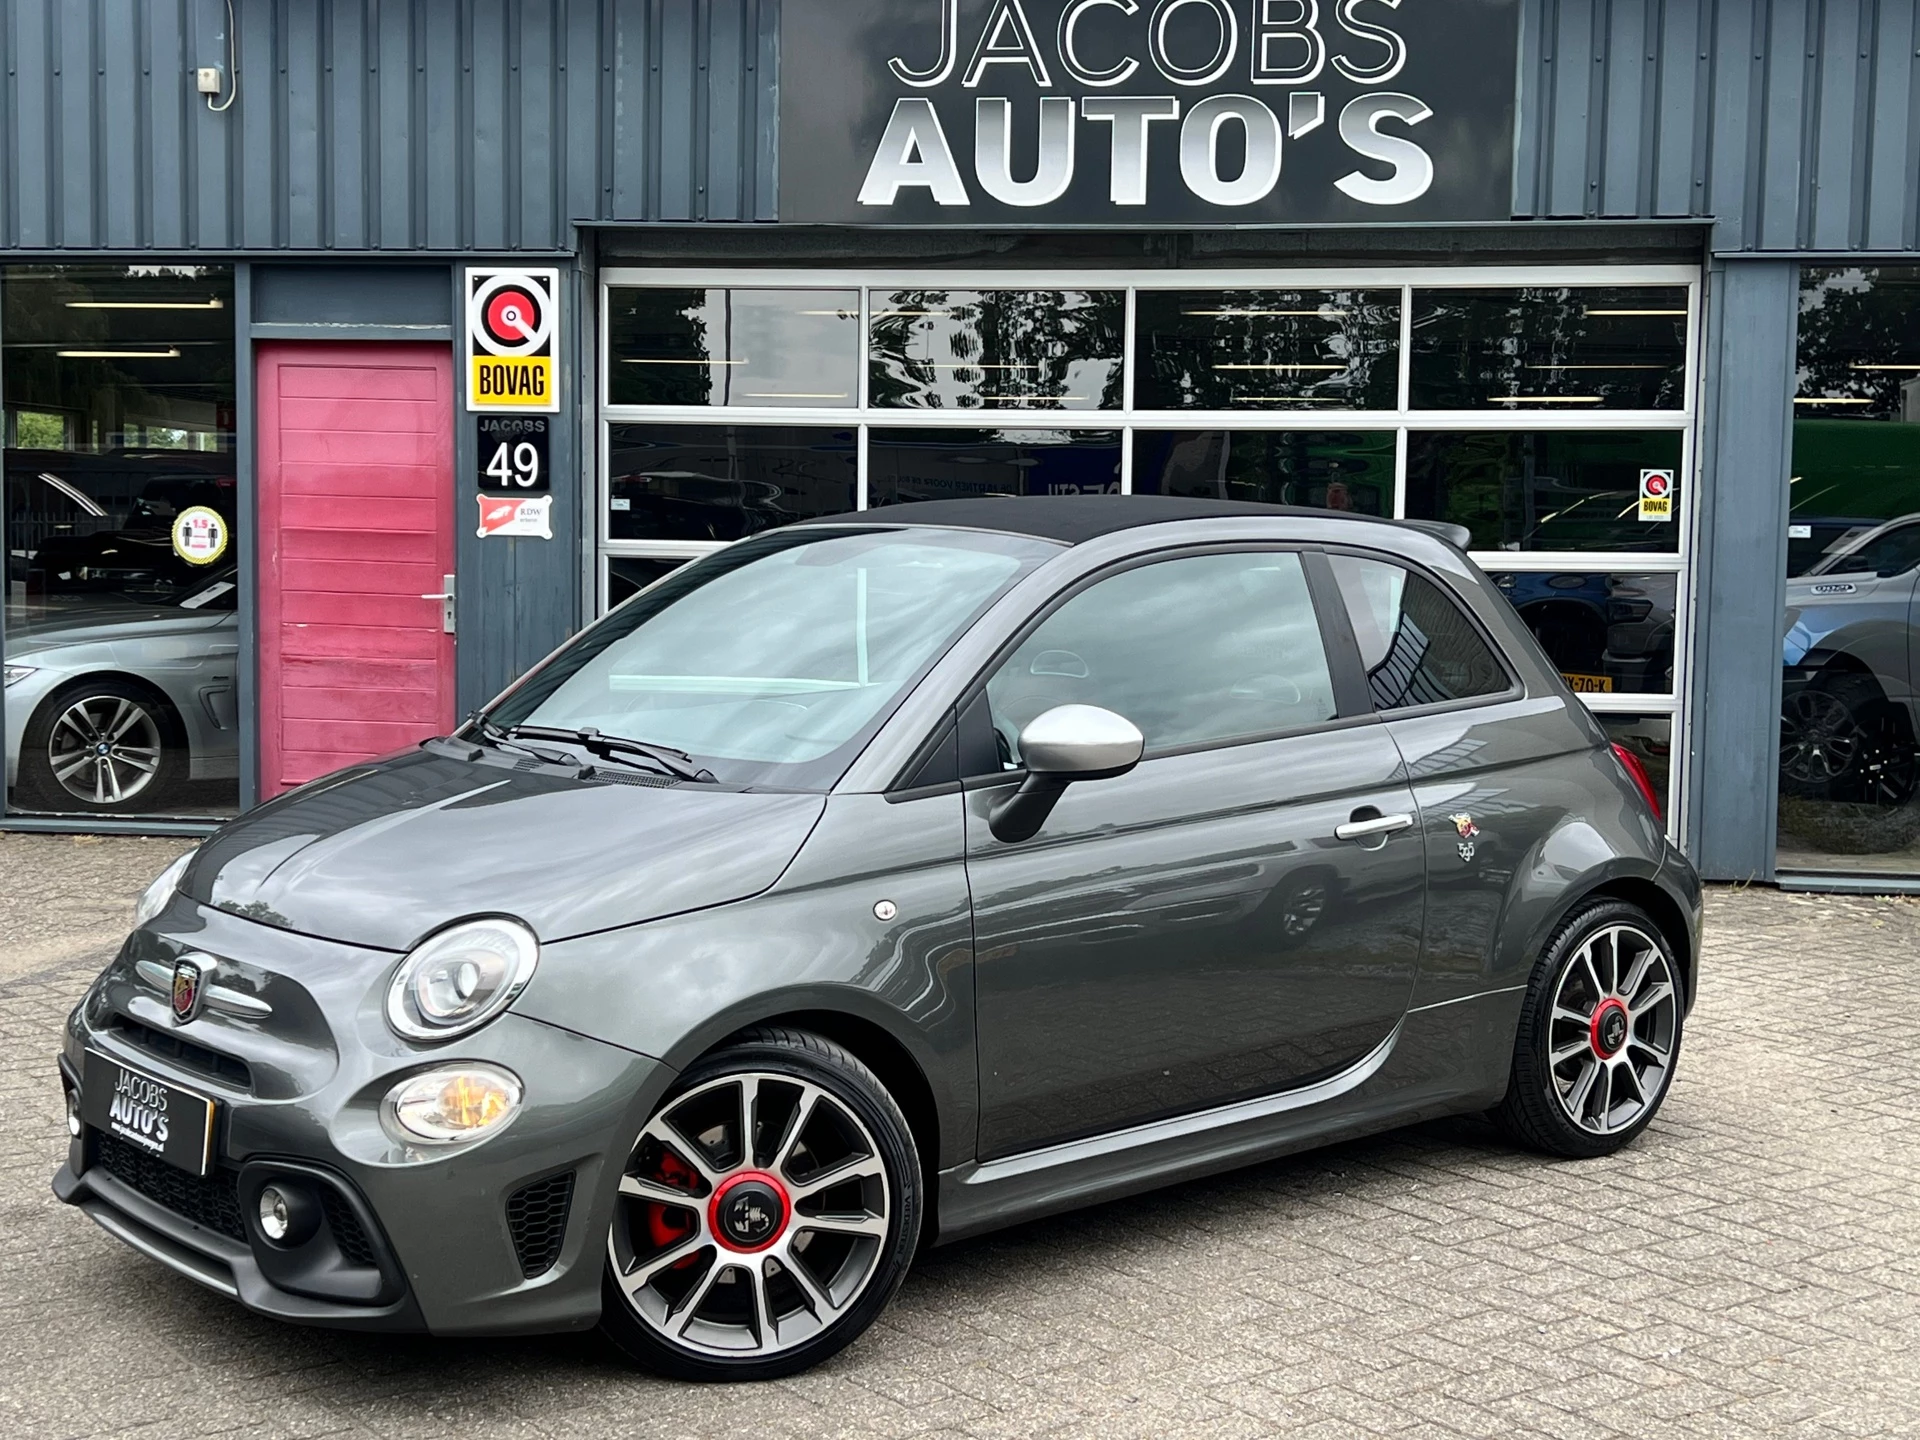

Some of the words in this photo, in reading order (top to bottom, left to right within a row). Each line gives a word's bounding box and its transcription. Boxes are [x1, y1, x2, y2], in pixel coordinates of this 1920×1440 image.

[888, 0, 1407, 87] JACOBS
[857, 92, 1434, 206] AUTO'S
[479, 364, 545, 396] BOVAG
[480, 419, 545, 432] JACOBS
[486, 442, 539, 487] 49
[192, 519, 208, 528] 1.5
[1644, 501, 1668, 511] BOVAG
[1457, 842, 1475, 862] 595
[114, 1068, 168, 1111] JACOBS
[109, 1091, 169, 1141] AUTO'S
